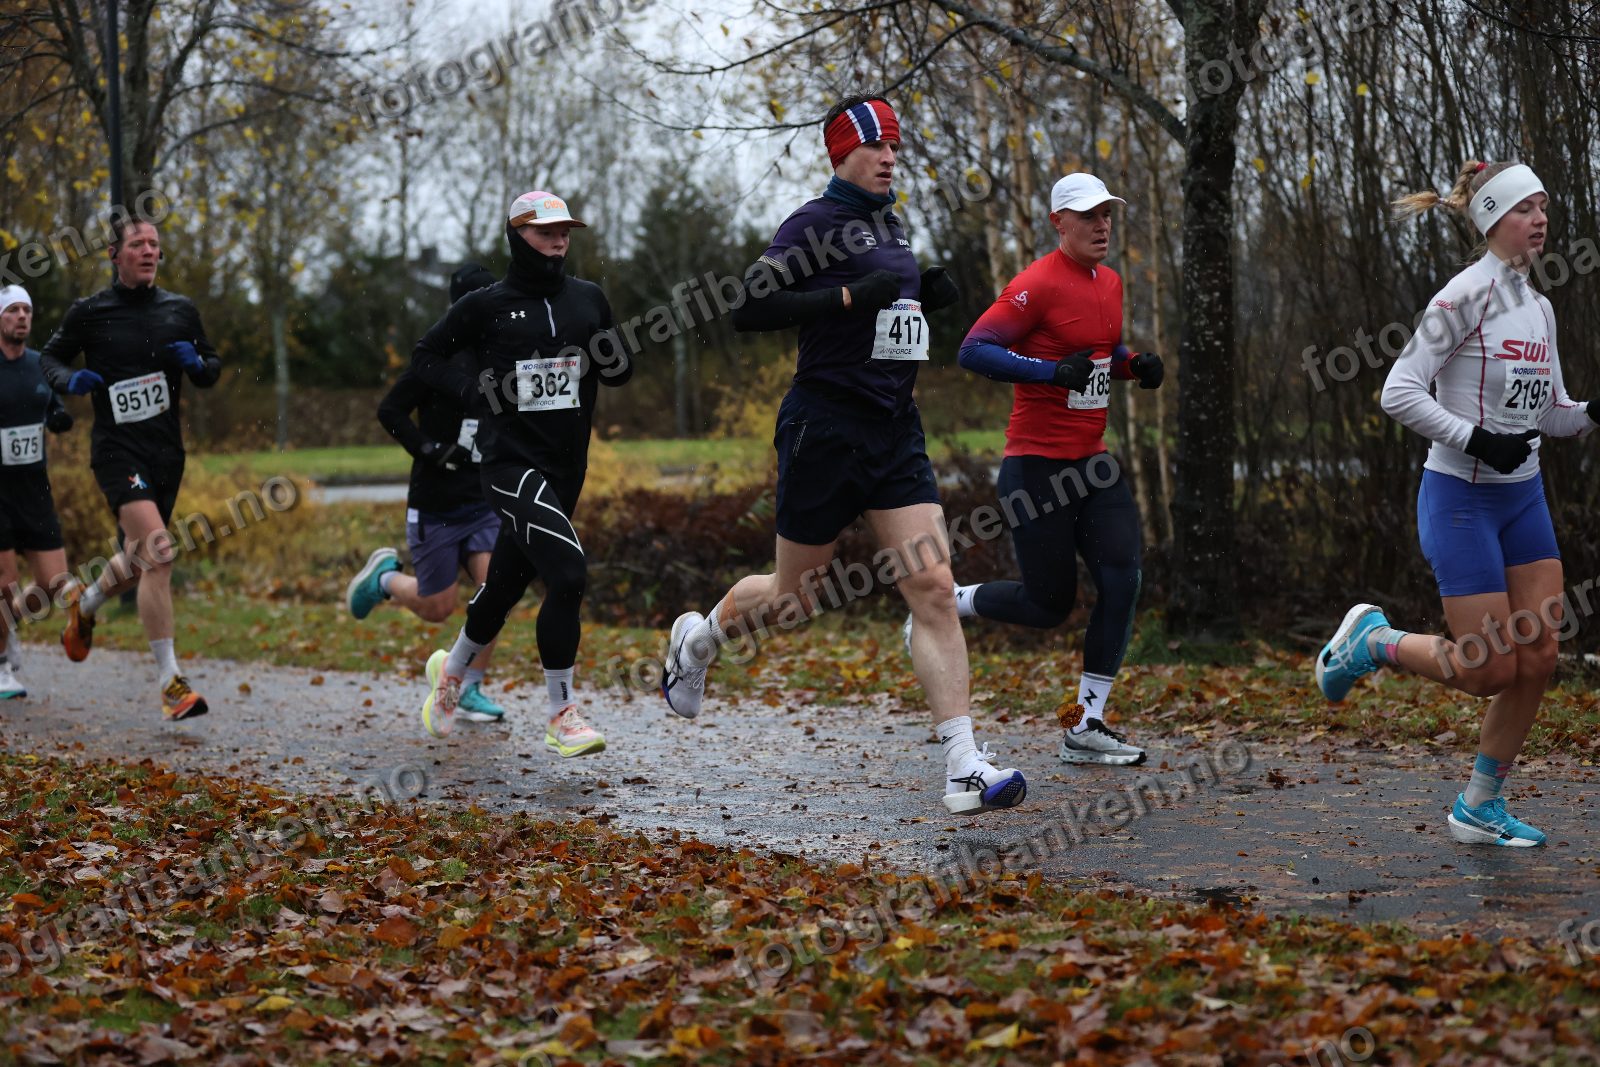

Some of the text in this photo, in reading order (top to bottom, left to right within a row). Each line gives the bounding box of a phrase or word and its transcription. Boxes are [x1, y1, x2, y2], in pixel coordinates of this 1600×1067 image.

[889, 315, 921, 345] 417
[522, 361, 577, 371] NORGESTESTEN
[531, 371, 572, 399] 362
[1081, 371, 1110, 397] 185
[1505, 379, 1550, 411] 2195
[116, 384, 165, 413] 9512
[11, 437, 38, 457] 675
